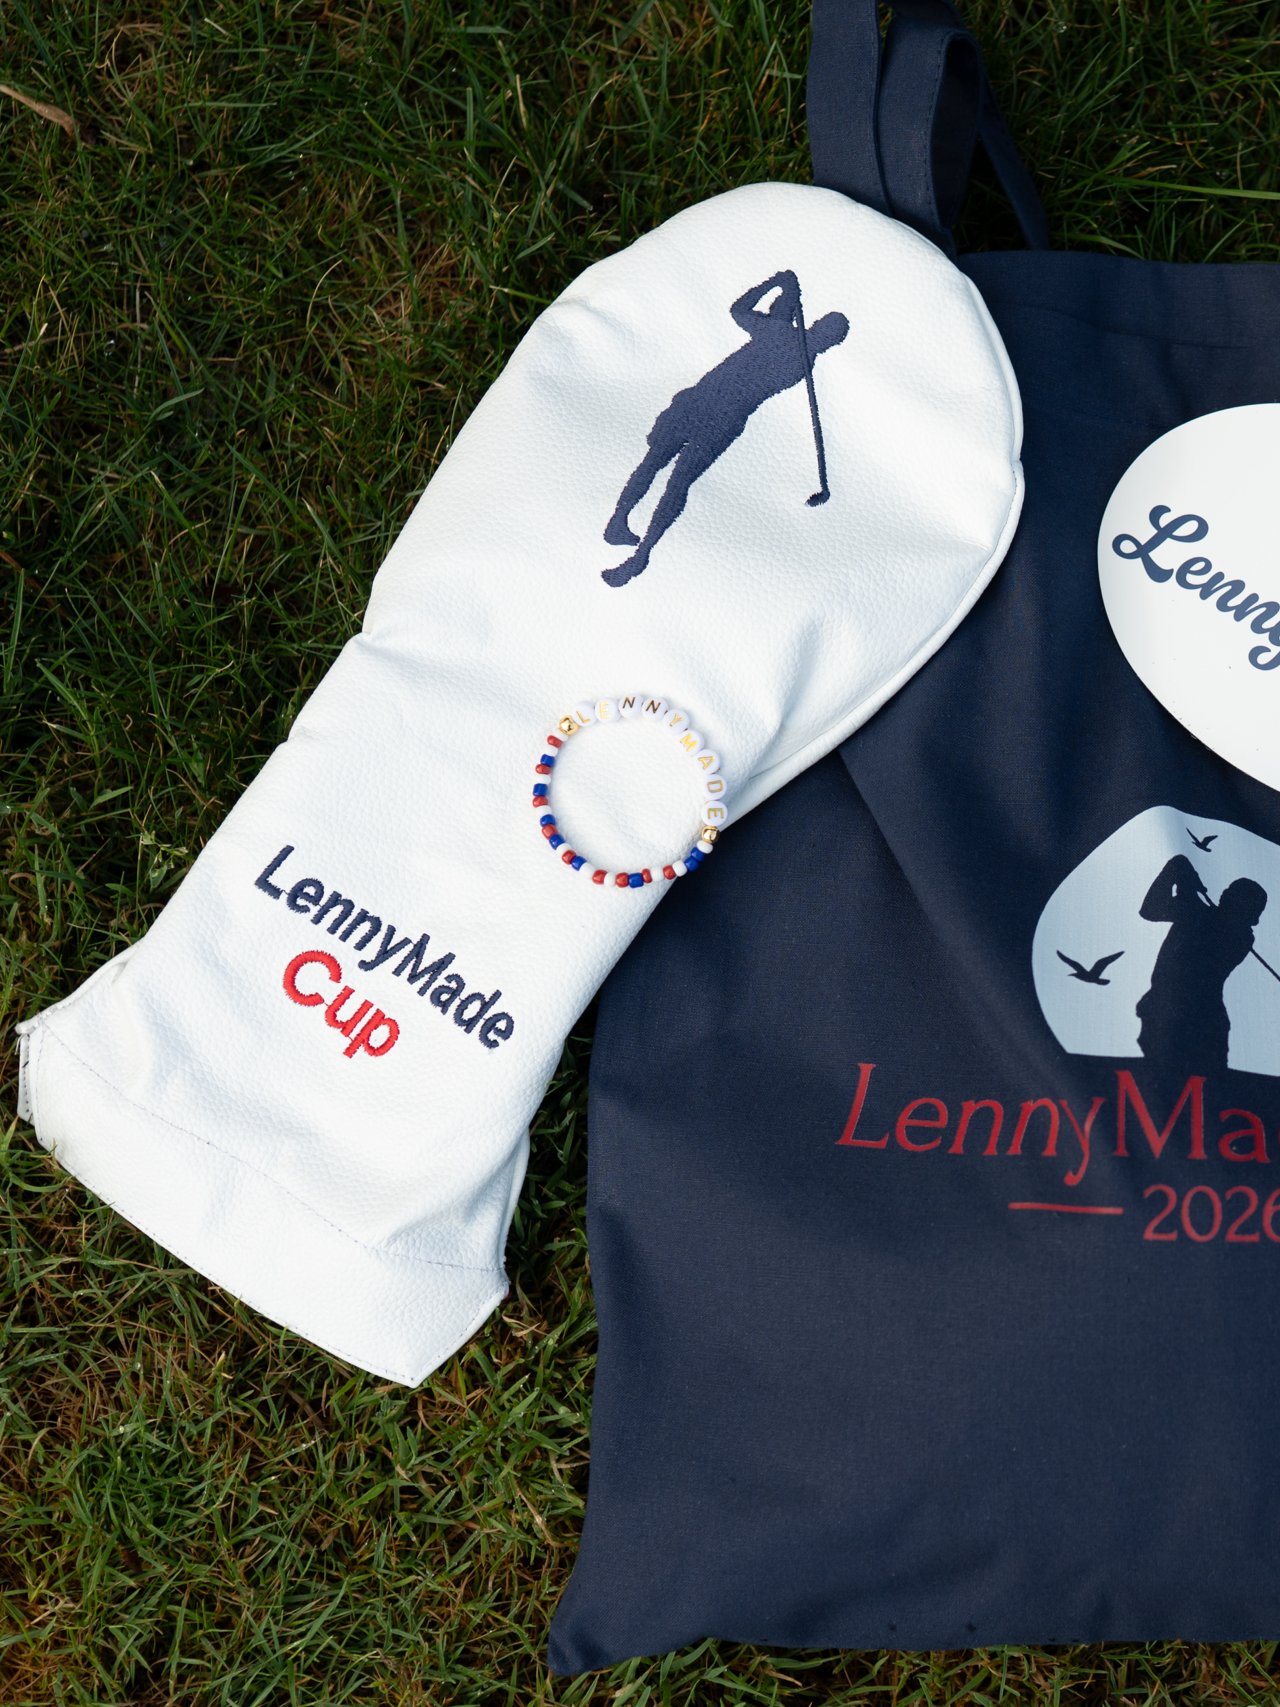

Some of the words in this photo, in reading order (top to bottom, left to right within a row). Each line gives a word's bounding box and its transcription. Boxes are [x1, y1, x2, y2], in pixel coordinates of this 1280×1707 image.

[576, 696, 725, 820] LENNYMADE
[254, 844, 515, 1051] LennyMade
[282, 949, 400, 1059] Cup
